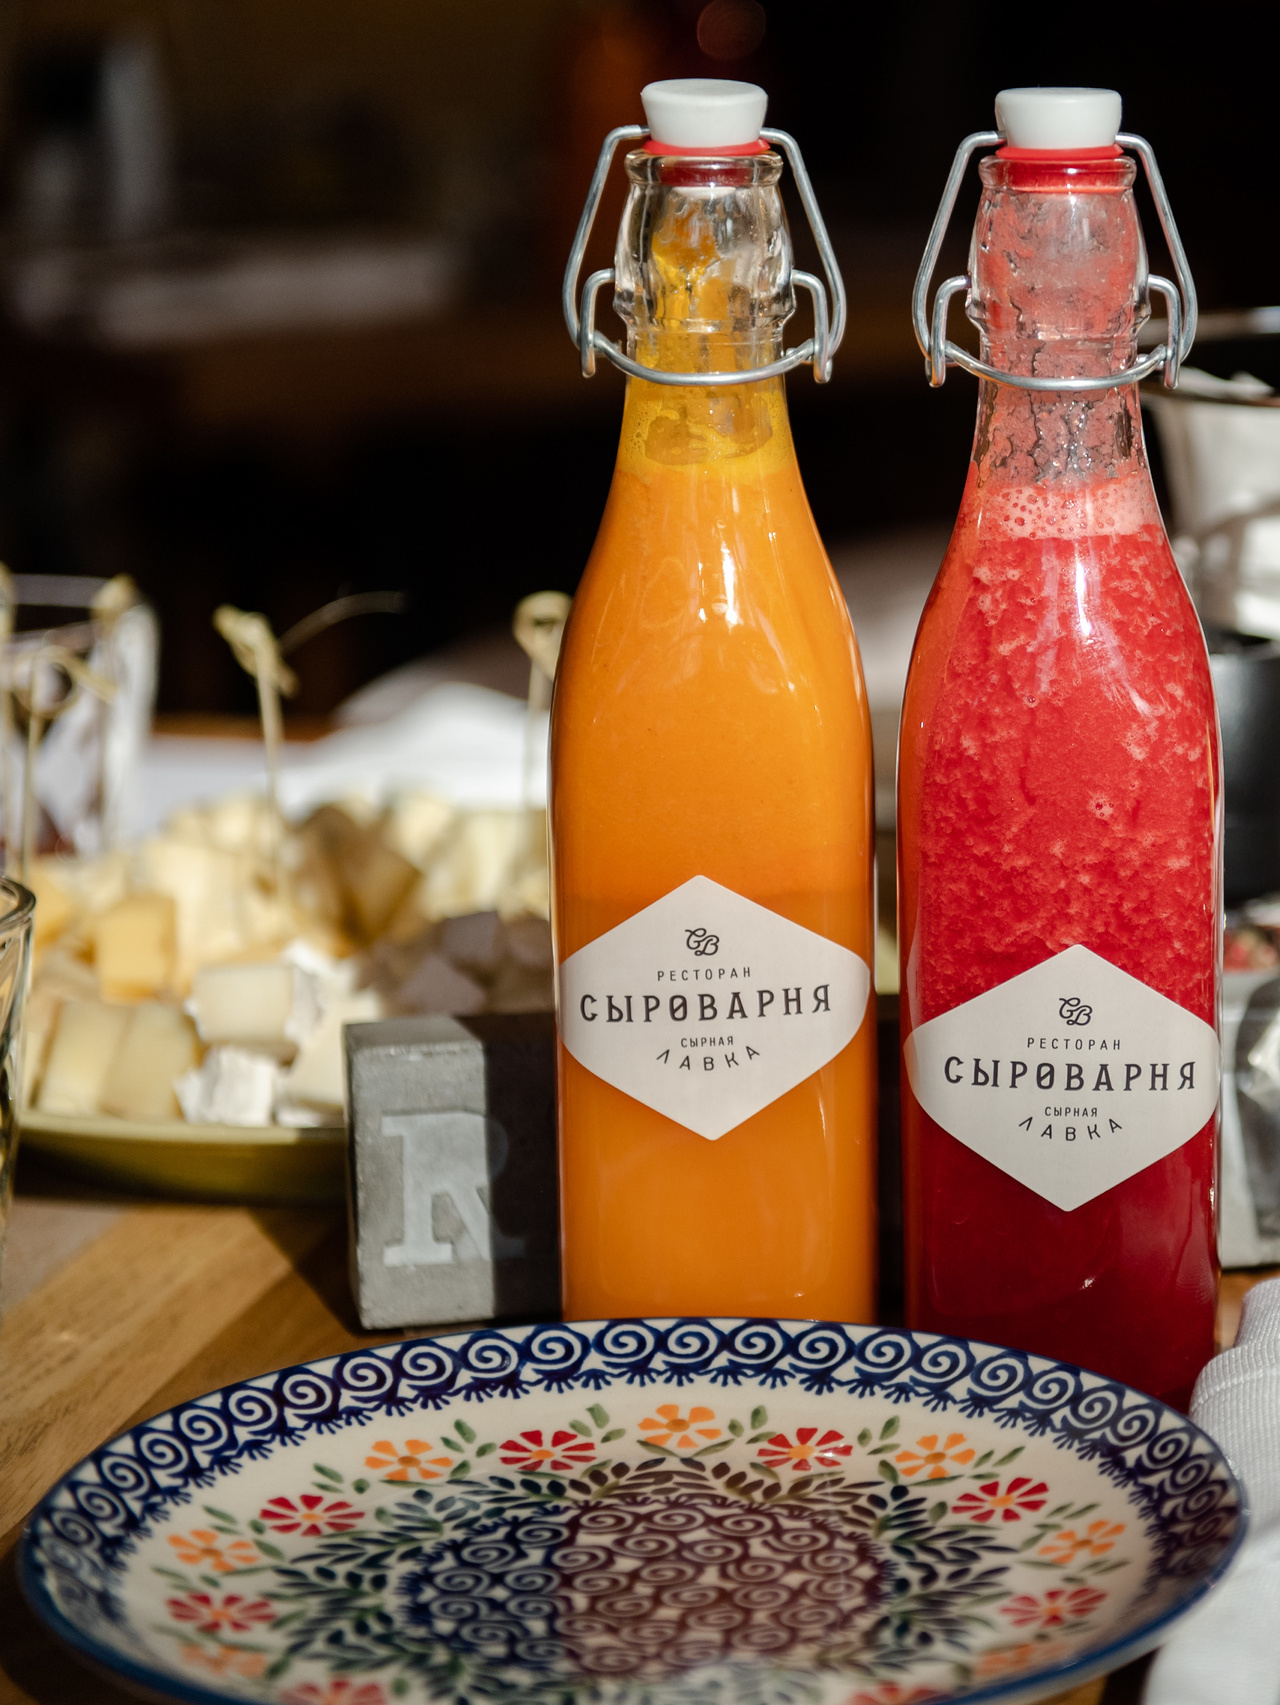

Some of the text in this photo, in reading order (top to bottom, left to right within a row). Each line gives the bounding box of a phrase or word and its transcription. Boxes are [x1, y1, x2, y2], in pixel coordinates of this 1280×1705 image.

[656, 966, 752, 982] РЕСТОРАН
[680, 1035, 734, 1048] СЫРНАЯ
[1026, 1036, 1121, 1051] РЕСТОРАН
[656, 1045, 760, 1071] ЛАВКА
[1044, 1106, 1098, 1118] СЫРНАЯ
[1018, 1116, 1123, 1141] ЛАВКА
